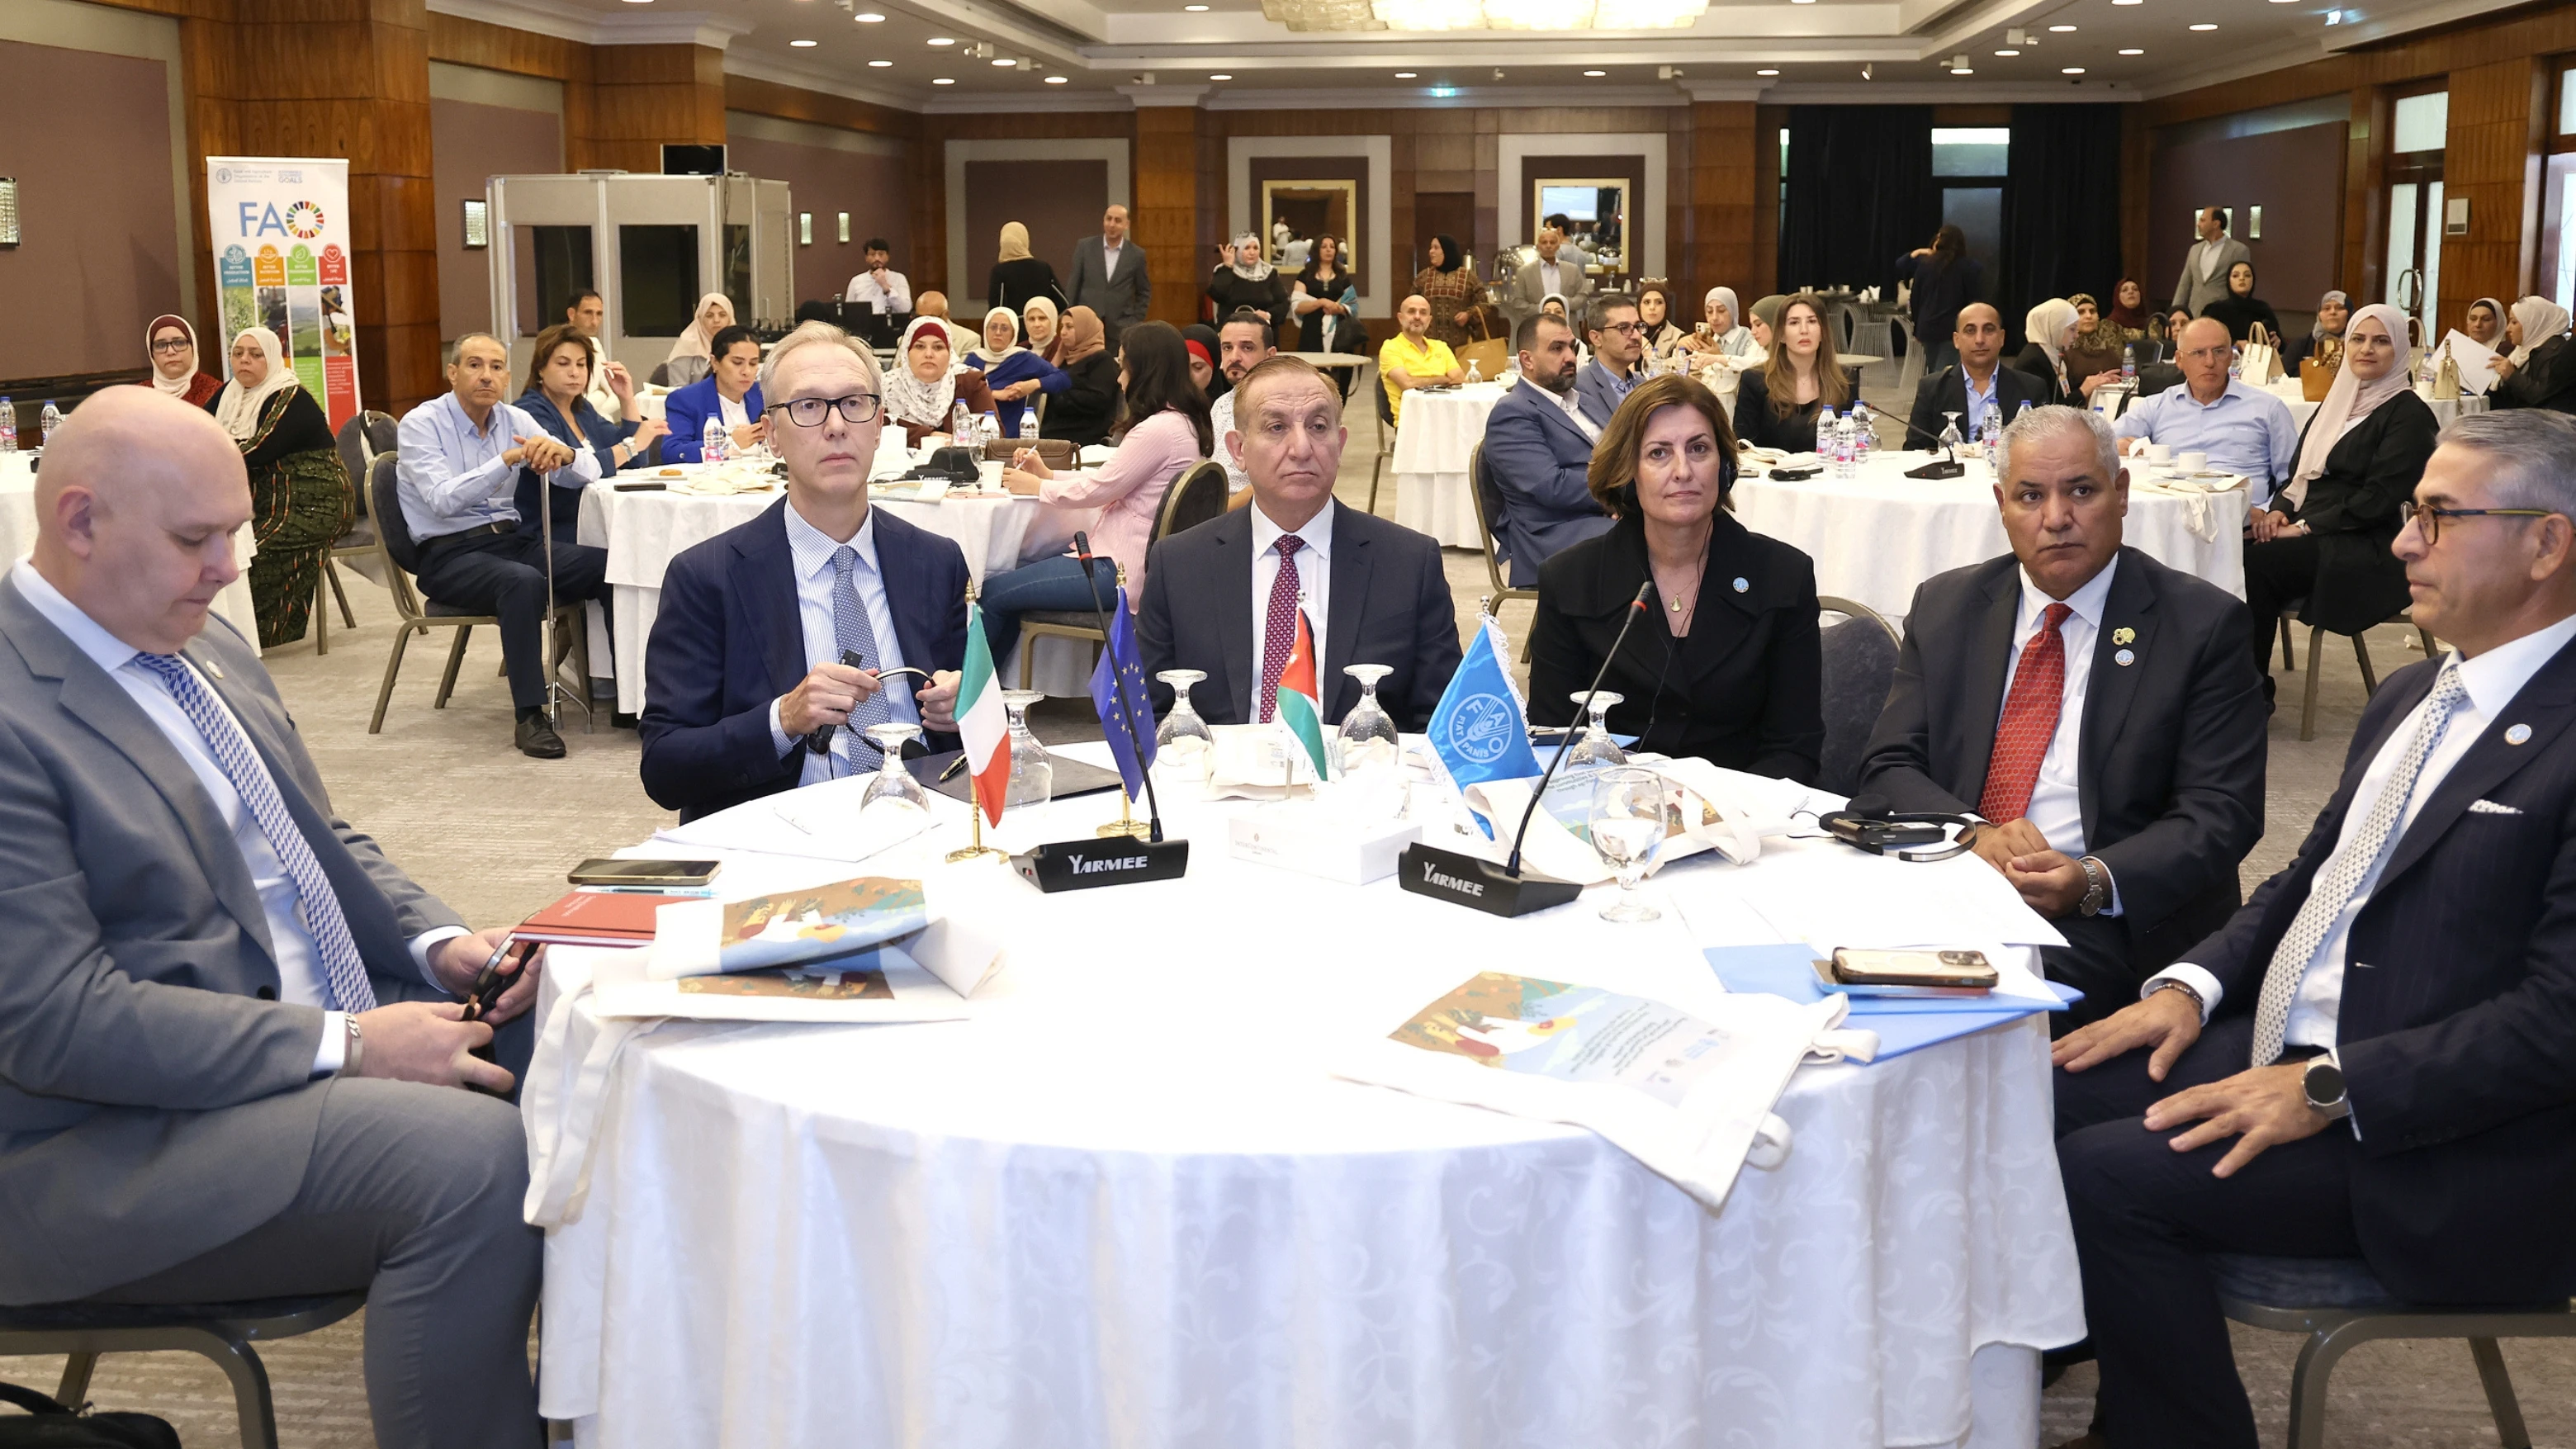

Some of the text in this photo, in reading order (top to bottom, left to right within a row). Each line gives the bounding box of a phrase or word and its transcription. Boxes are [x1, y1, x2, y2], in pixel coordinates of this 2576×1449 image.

[239, 201, 324, 239] FAO
[1453, 715, 1466, 740] FIAT
[1461, 741, 1489, 758] PANIS
[1068, 854, 1148, 874] YARMEE
[1423, 861, 1485, 897] YARMEE
